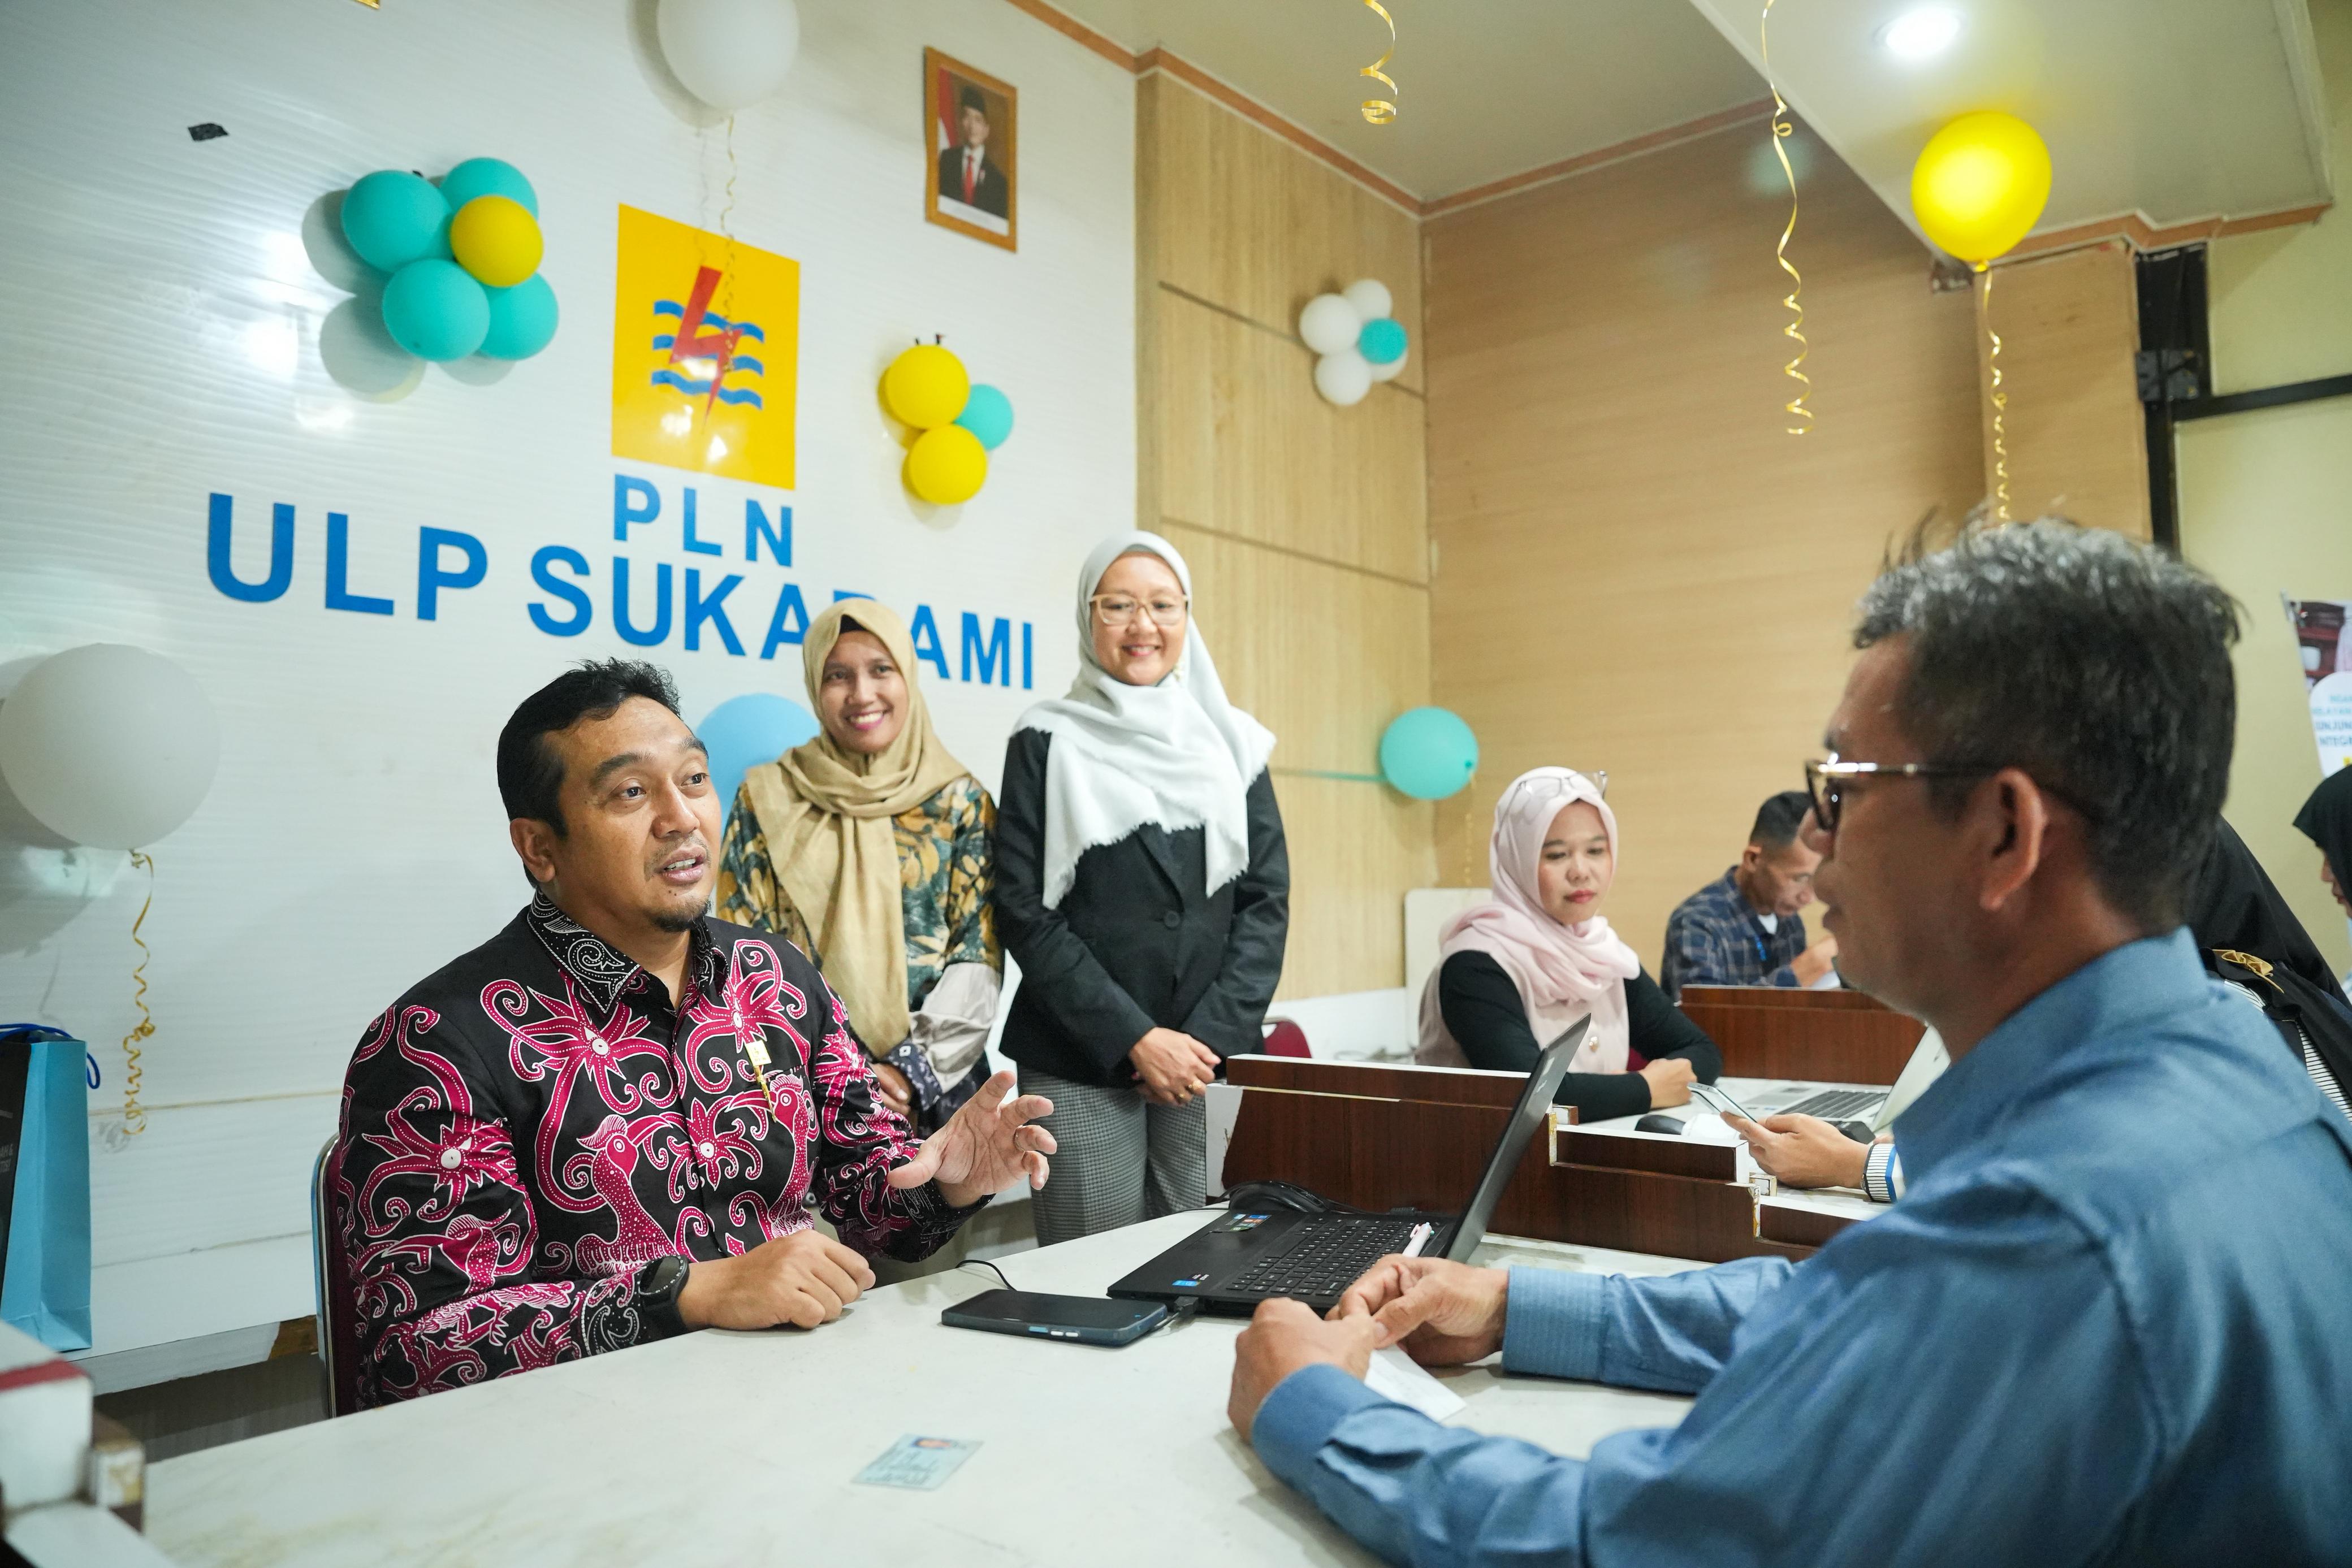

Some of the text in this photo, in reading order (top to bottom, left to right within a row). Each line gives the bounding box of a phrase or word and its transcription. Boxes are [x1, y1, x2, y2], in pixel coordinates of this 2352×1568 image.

[207, 492, 1033, 690] ULP SUKAAMI
[614, 474, 792, 567] PLN
